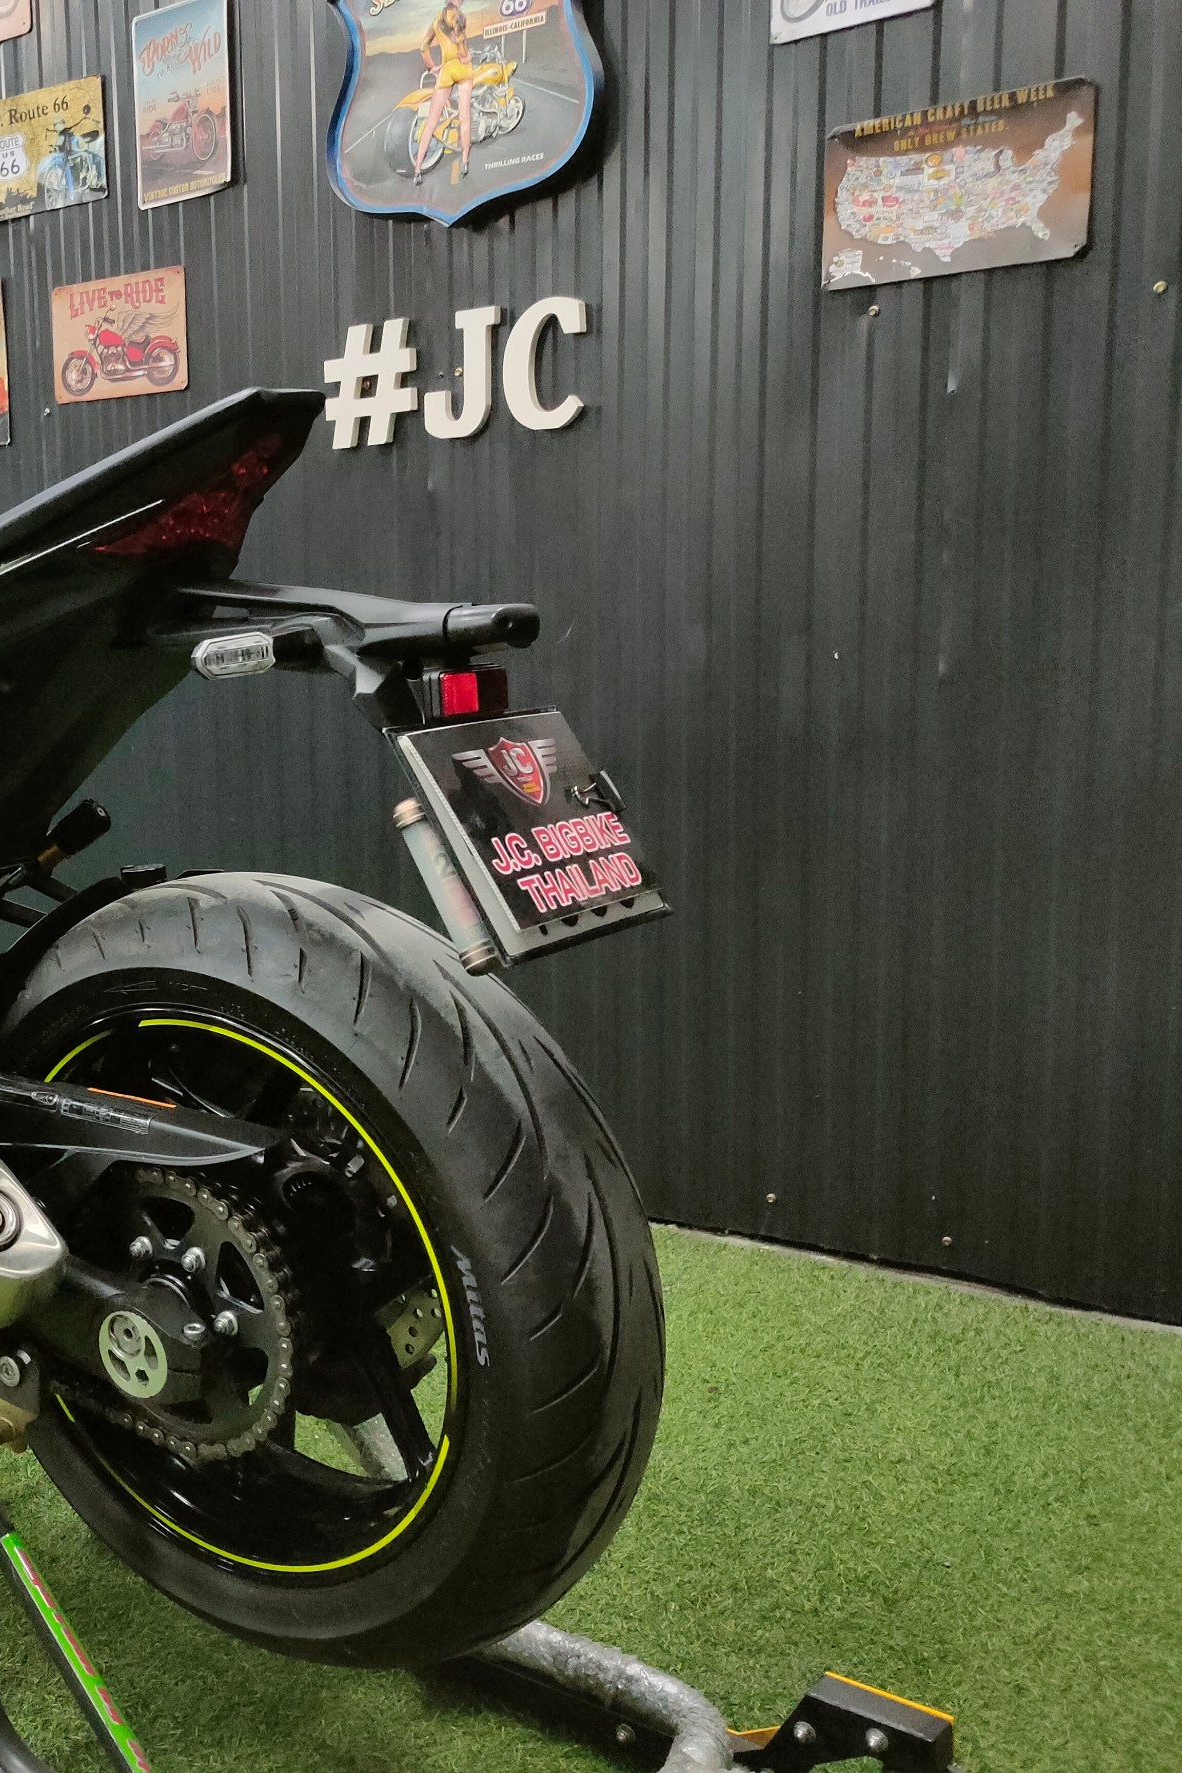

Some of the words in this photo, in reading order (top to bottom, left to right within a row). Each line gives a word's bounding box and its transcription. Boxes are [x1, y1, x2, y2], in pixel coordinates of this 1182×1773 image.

[484, 14, 545, 37] ILLINOIS-CALIFORNIA
[825, 0, 847, 17] OLD
[139, 25, 185, 76] BORN
[180, 25, 221, 75] WILD
[8, 103, 49, 125] Route
[53, 94, 69, 113] 66
[854, 111, 922, 138] AMERICAN
[927, 103, 969, 121] CRAFT
[977, 94, 1010, 113] BEER
[1017, 83, 1055, 104] WEEK
[0, 158, 20, 178] 66
[2, 151, 16, 159] US
[484, 157, 520, 170] THRILLING
[520, 152, 545, 163] RACES
[68, 287, 108, 320] LIVE
[108, 289, 123, 301] TO
[123, 276, 166, 309] RIDE
[500, 747, 534, 777] JC
[490, 832, 542, 876] J.C.
[530, 810, 632, 862] BIGBIKE
[516, 851, 643, 914] THAILAND
[450, 1245, 490, 1368] Mitas
